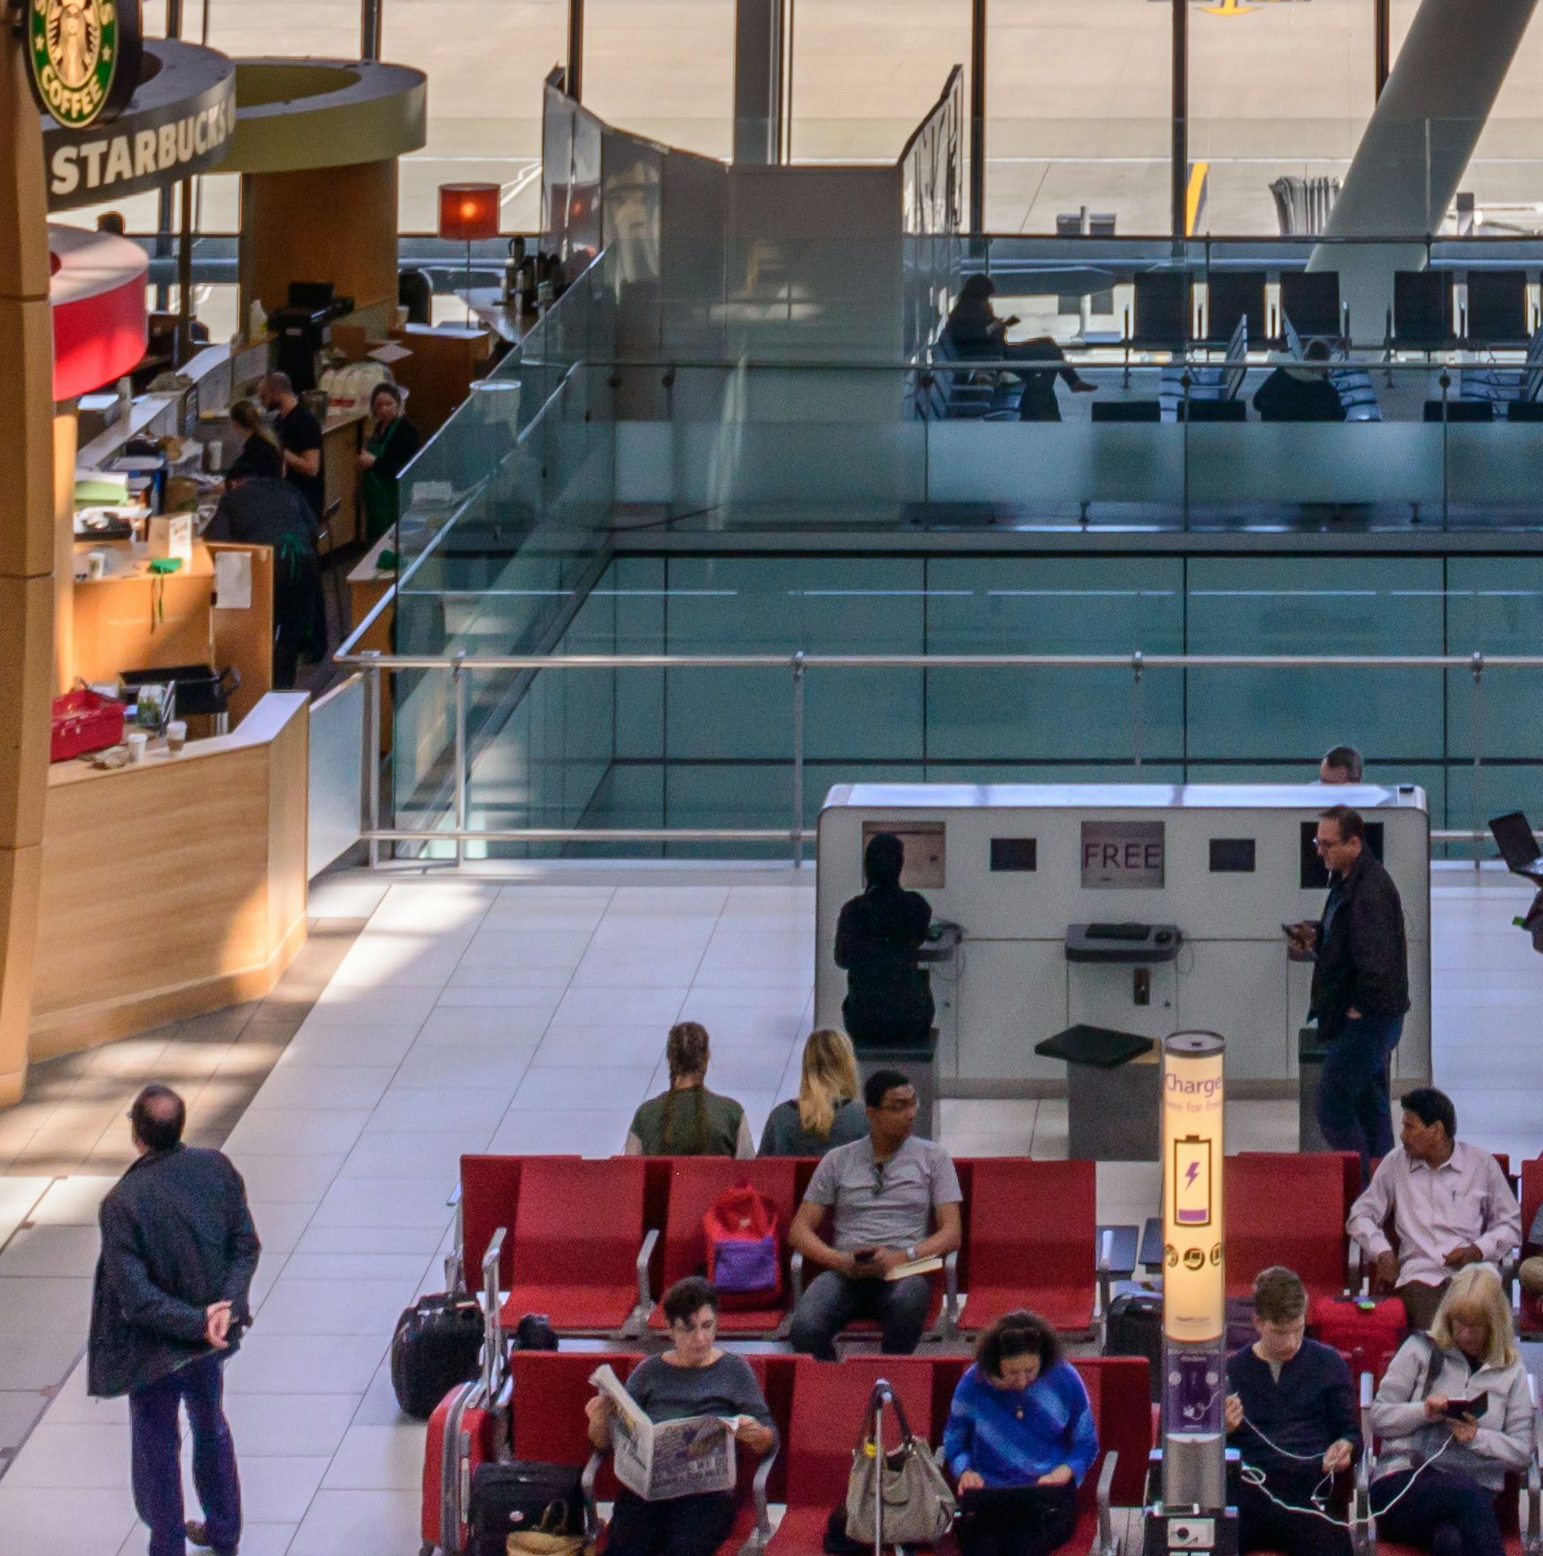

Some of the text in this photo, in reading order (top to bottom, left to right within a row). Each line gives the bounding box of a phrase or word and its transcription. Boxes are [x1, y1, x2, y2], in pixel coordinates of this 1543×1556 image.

[41, 64, 104, 118] COFFEE
[50, 104, 226, 195] STARBUCKS
[1085, 843, 1160, 869] FREE
